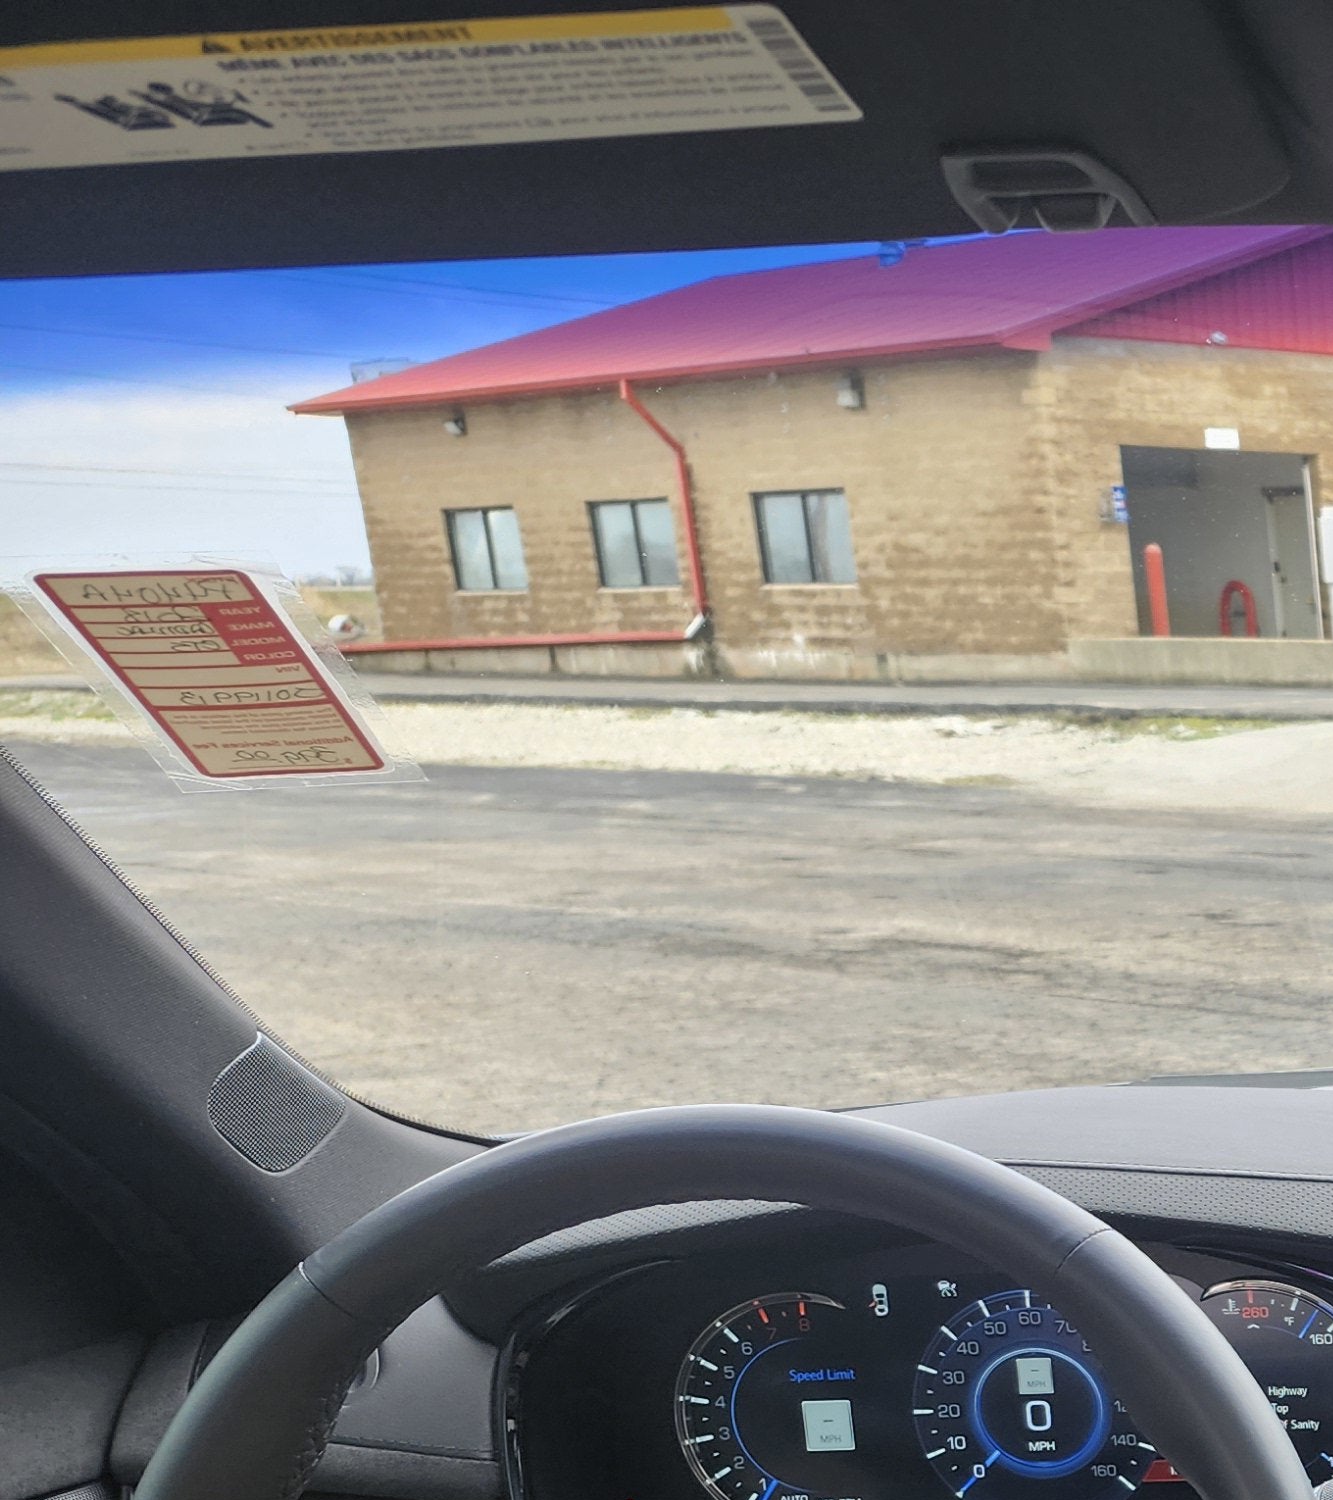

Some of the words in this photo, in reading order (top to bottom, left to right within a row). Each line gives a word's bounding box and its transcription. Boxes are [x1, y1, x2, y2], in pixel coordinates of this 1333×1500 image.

[1018, 1311, 1042, 1325] 60
[1242, 1307, 1269, 1319] 260
[799, 1318, 810, 1331] 8
[983, 1321, 1007, 1335] 50
[768, 1327, 777, 1339] 7
[1309, 1334, 1333, 1345] 160
[741, 1342, 752, 1355] 6
[956, 1341, 980, 1355] 40
[723, 1365, 735, 1378] 5
[789, 1369, 824, 1383] Speed
[827, 1369, 856, 1381] Limit
[942, 1371, 965, 1385] 30
[1027, 1380, 1046, 1388] MPH
[1268, 1386, 1308, 1398] Highway
[714, 1396, 726, 1407] 4
[937, 1404, 961, 1418] 20
[1025, 1400, 1052, 1431] 0
[1271, 1403, 1289, 1415] Top
[1290, 1419, 1320, 1431] Sanity
[718, 1427, 731, 1440] 3
[820, 1434, 842, 1444] MPH
[1110, 1433, 1137, 1447] 140
[946, 1435, 967, 1450] 10
[1028, 1441, 1056, 1452] MPH
[733, 1456, 745, 1470] 2
[973, 1464, 986, 1478] 0
[1090, 1464, 1117, 1477] 160
